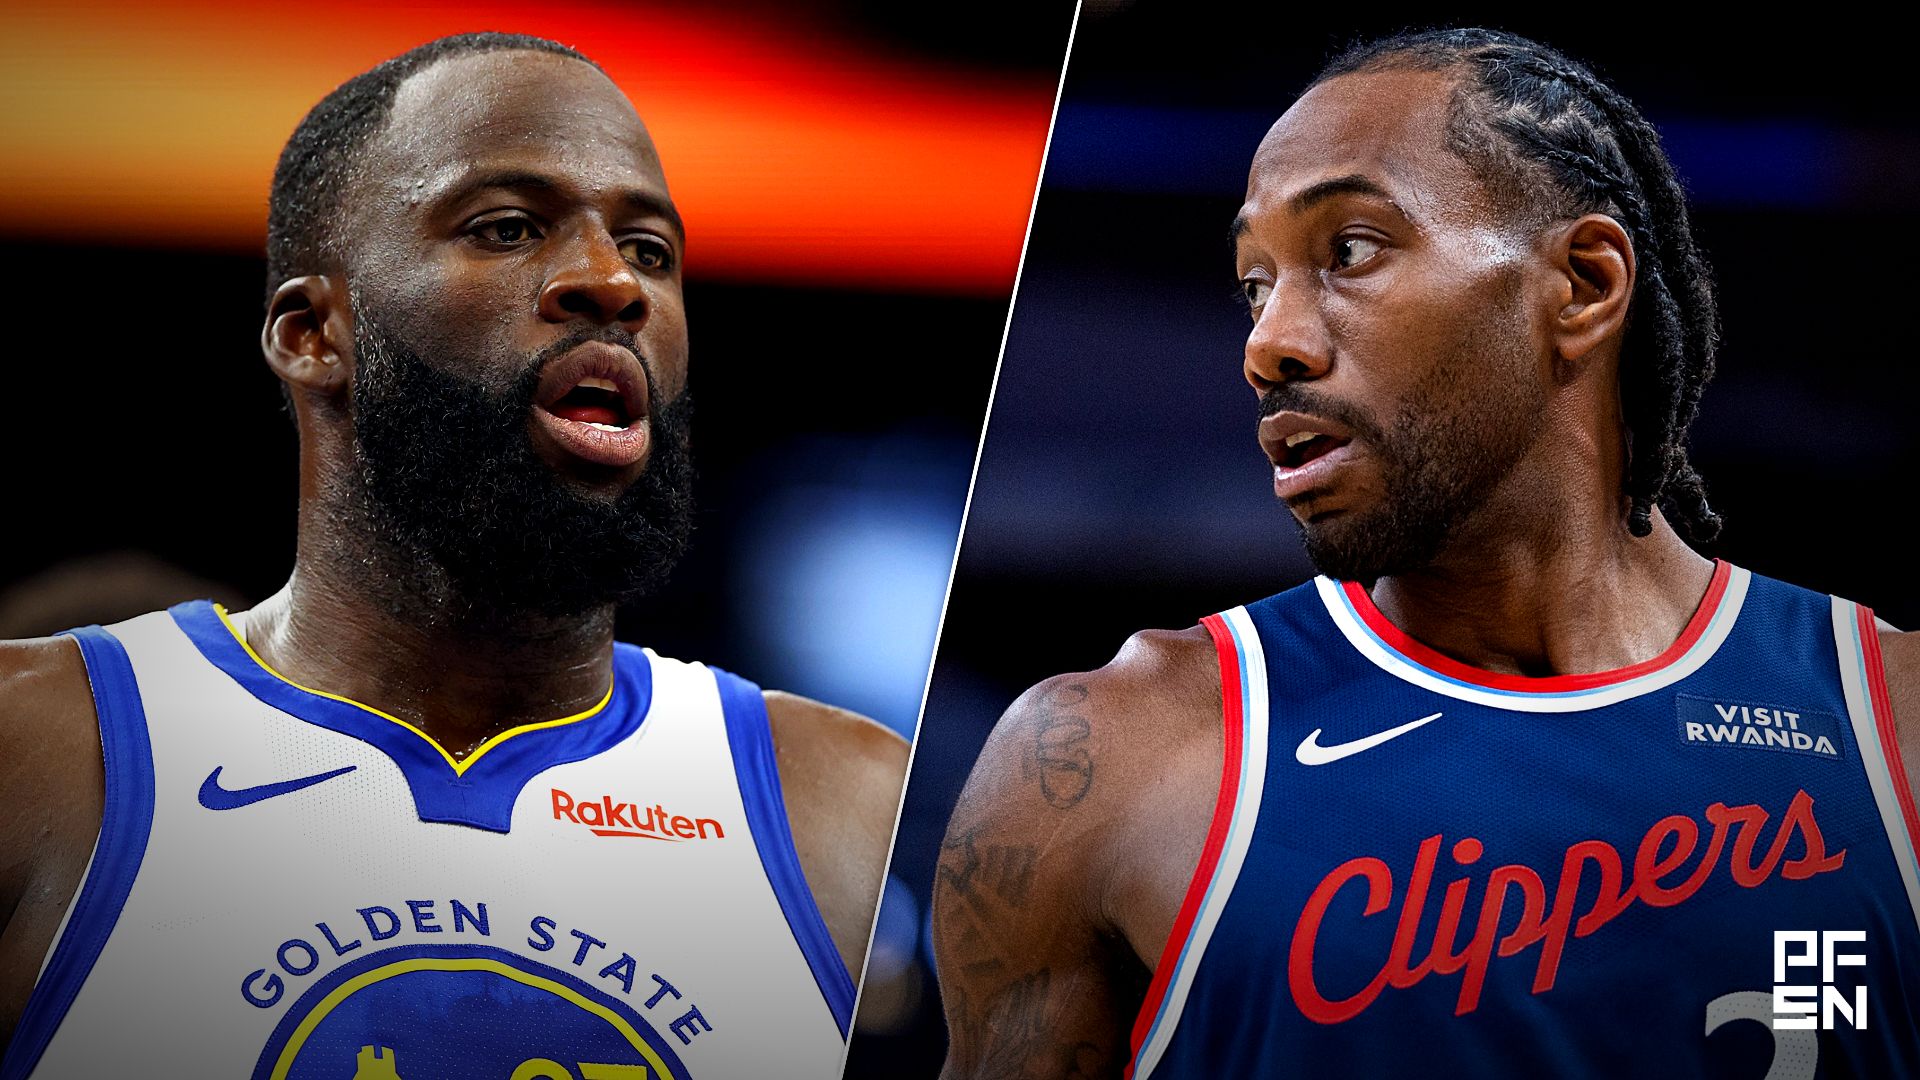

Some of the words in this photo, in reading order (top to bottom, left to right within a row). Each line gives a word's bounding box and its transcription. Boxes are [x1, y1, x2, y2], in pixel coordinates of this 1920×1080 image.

[1685, 721, 1837, 755] RWANDA
[1714, 704, 1799, 732] VISIT
[551, 788, 725, 841] Rakuten
[1289, 789, 1846, 1024] Clippers
[241, 899, 491, 1009] GOLDEN
[527, 915, 713, 1045] STATE
